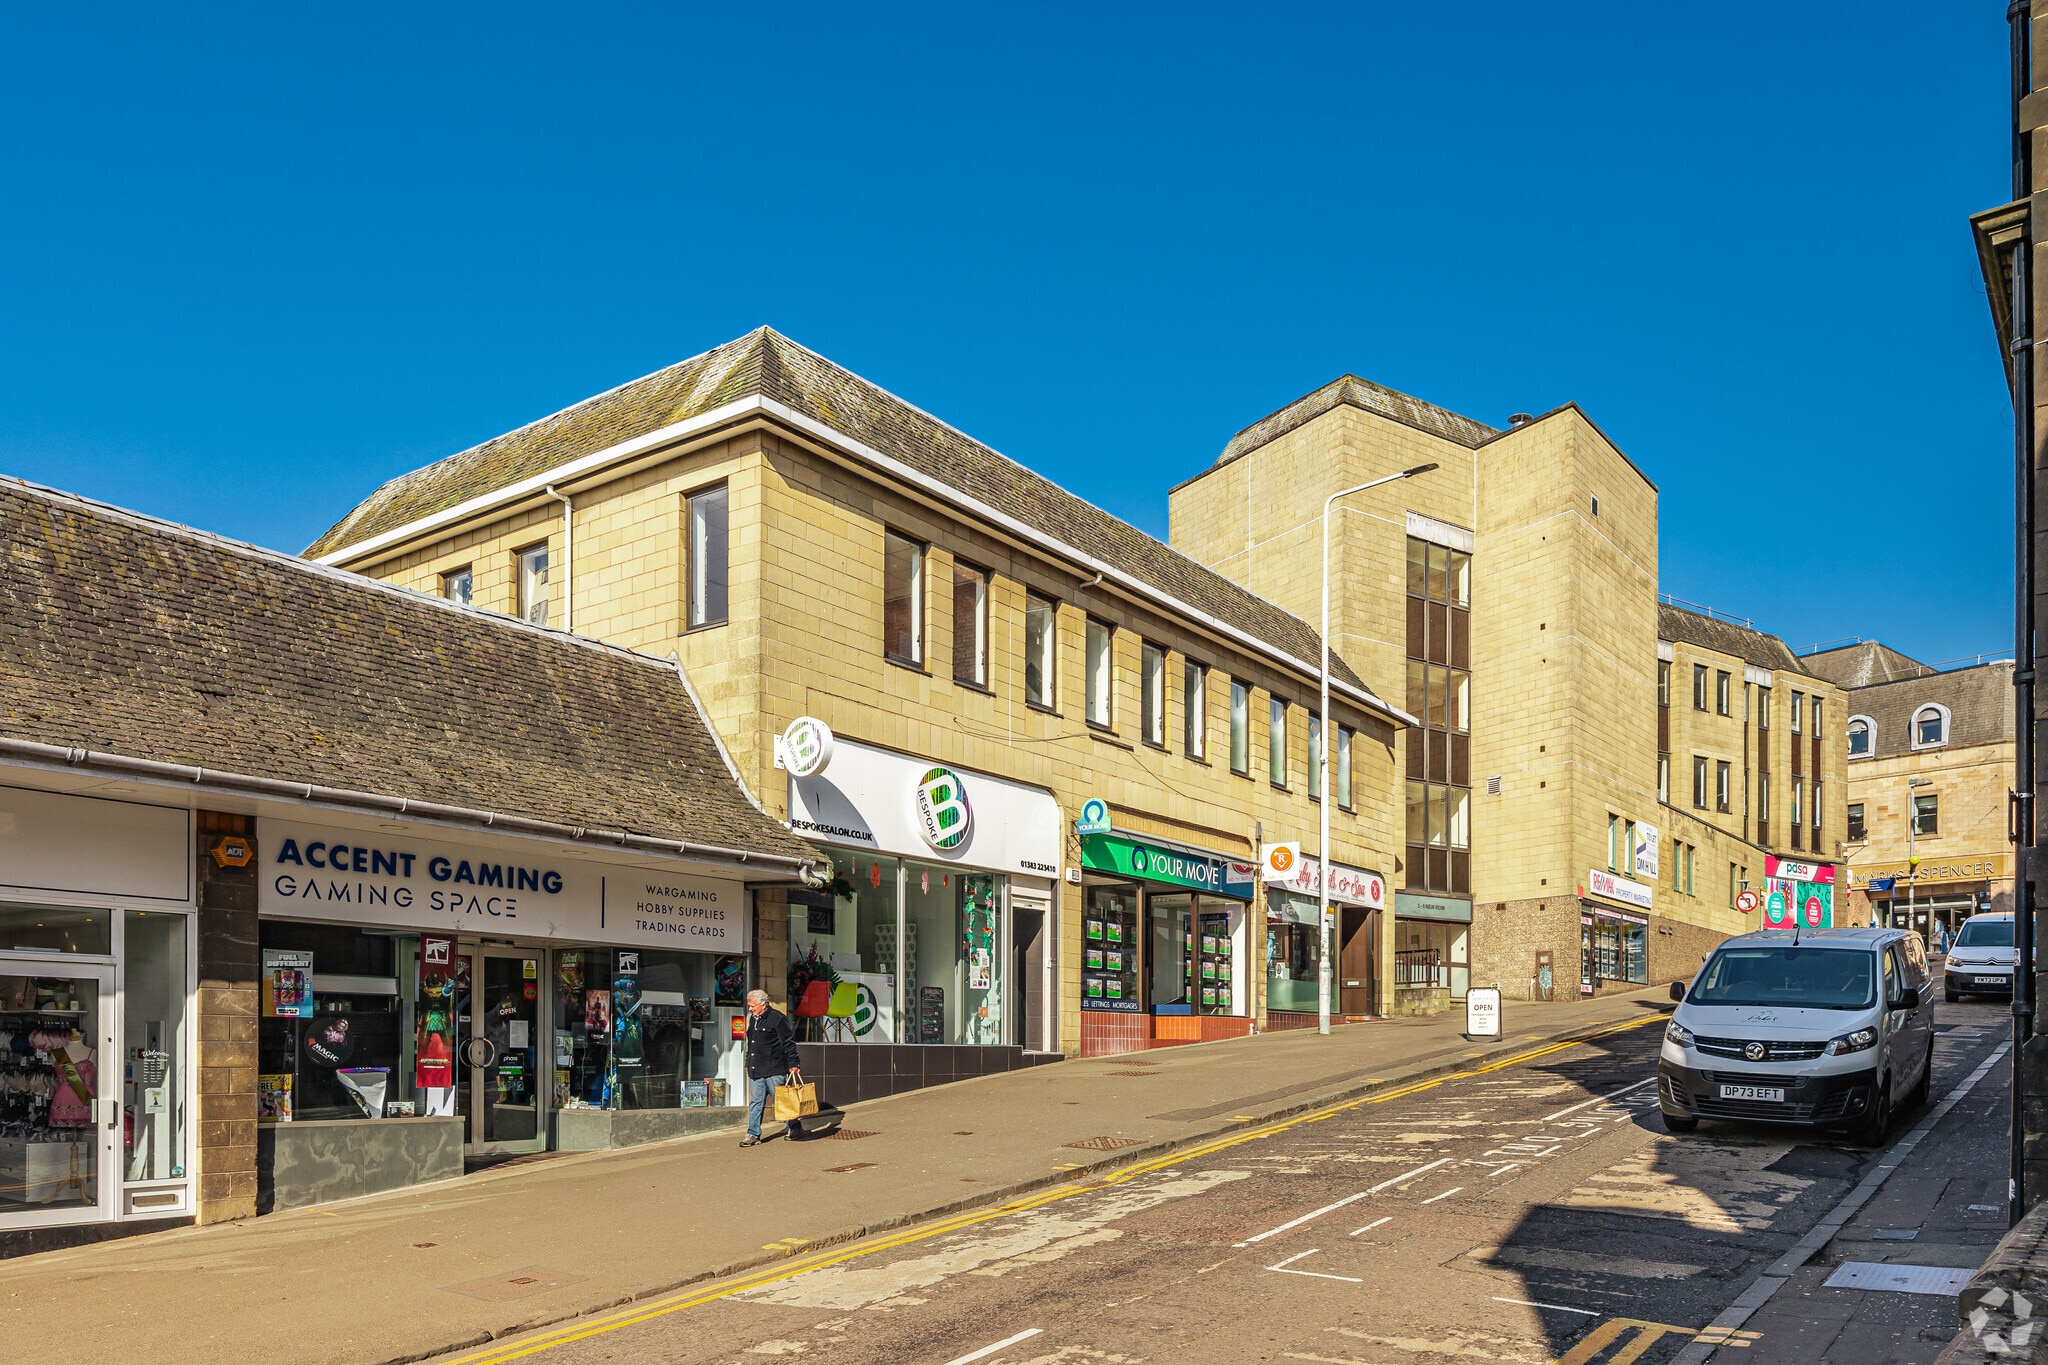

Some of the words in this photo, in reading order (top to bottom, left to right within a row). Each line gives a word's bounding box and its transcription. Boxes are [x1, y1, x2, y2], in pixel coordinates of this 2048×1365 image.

[786, 739, 800, 769] BESPOKE
[917, 788, 940, 841] BESPOKE
[791, 818, 873, 842] BESPOKESALON.CO.UK
[226, 848, 244, 856] ADT
[277, 838, 416, 878] ACCENT
[429, 857, 563, 894] GAMING
[1020, 860, 1036, 870] 01383
[1037, 863, 1056, 873] 223410
[1150, 853, 1183, 877] YOUR
[1185, 861, 1219, 885] MOVE
[1786, 862, 1808, 875] pdsa
[1920, 861, 1995, 880] SPENCER
[645, 884, 718, 903] WARGAMING
[1351, 874, 1366, 897] Spa
[275, 874, 413, 908] GAMING
[430, 890, 518, 918] SPACE
[637, 901, 675, 915] HOBBY
[678, 906, 726, 921] SUPPLIES
[635, 919, 687, 934] TRADING
[690, 925, 726, 938] CARDS
[266, 960, 311, 968] DIFFERENT
[499, 1007, 516, 1016] OPEN
[1112, 1002, 1138, 1010] MORTGAGES
[1473, 1004, 1493, 1012] OPEN
[141, 1049, 170, 1058] Welcome
[312, 1043, 340, 1063] MAGIC
[1724, 1086, 1754, 1098] DP73
[1757, 1088, 1779, 1099] EFT
[1464, 1135, 1561, 1167] ONLY
